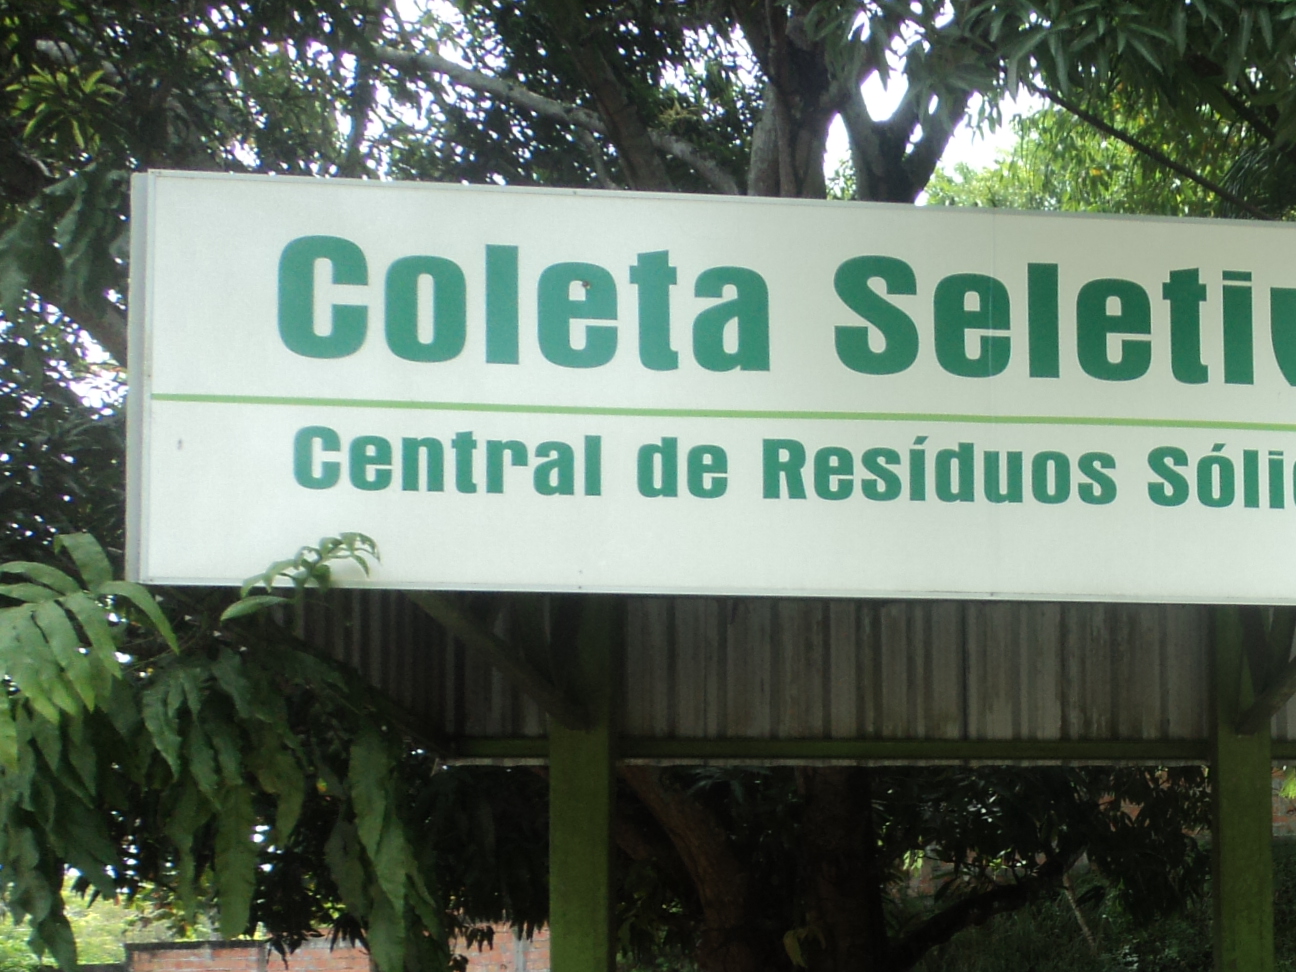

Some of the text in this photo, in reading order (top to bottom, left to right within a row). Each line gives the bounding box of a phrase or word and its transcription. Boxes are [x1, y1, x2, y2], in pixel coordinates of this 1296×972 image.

[278, 235, 771, 373] Coleta
[292, 426, 603, 497] Central
[637, 437, 728, 499] de
[762, 435, 1117, 505] Resíduos
